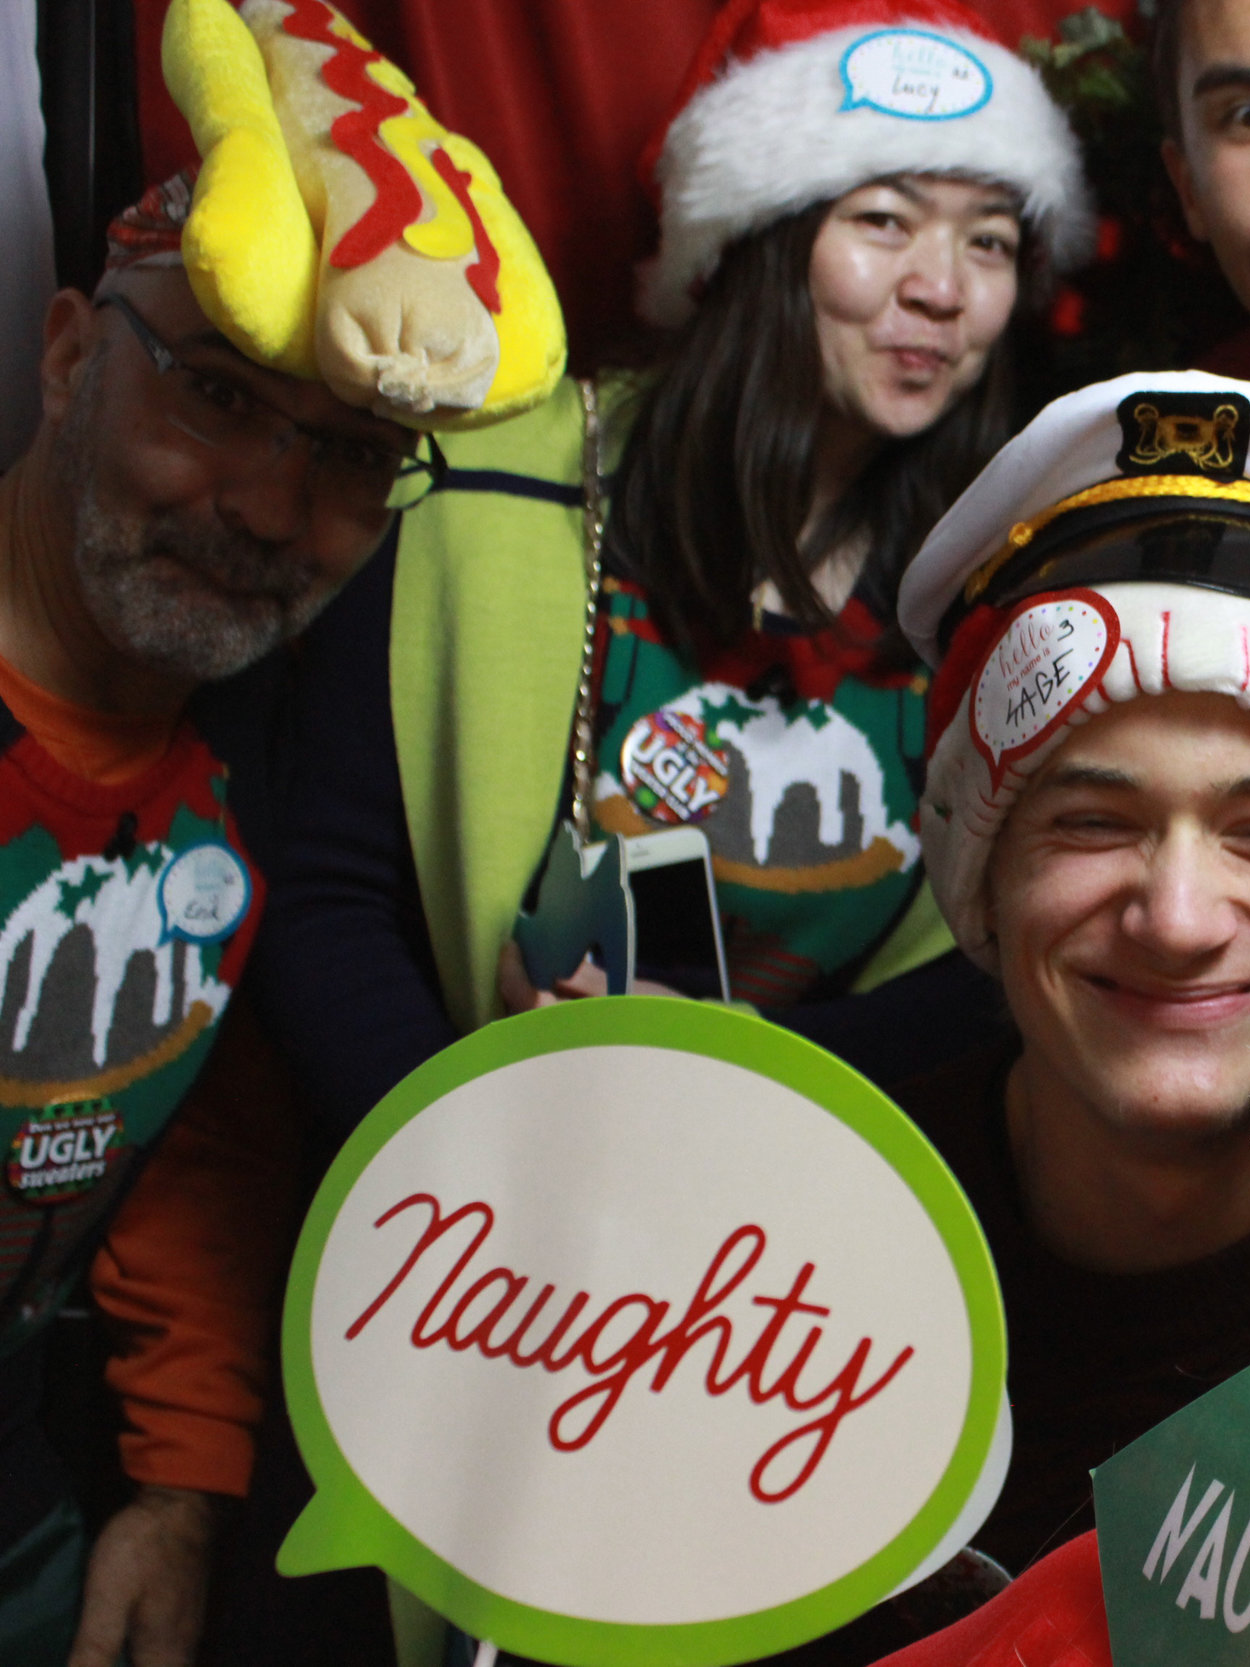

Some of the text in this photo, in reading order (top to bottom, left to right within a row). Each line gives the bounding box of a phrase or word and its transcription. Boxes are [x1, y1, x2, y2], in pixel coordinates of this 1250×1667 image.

[999, 623, 1054, 679] hello
[1056, 618, 1075, 642] 3
[1007, 678, 1020, 692] my
[1020, 655, 1042, 678] name
[620, 718, 720, 813] UGLY
[20, 1124, 117, 1169] UGLY
[345, 1192, 914, 1504] Naughty
